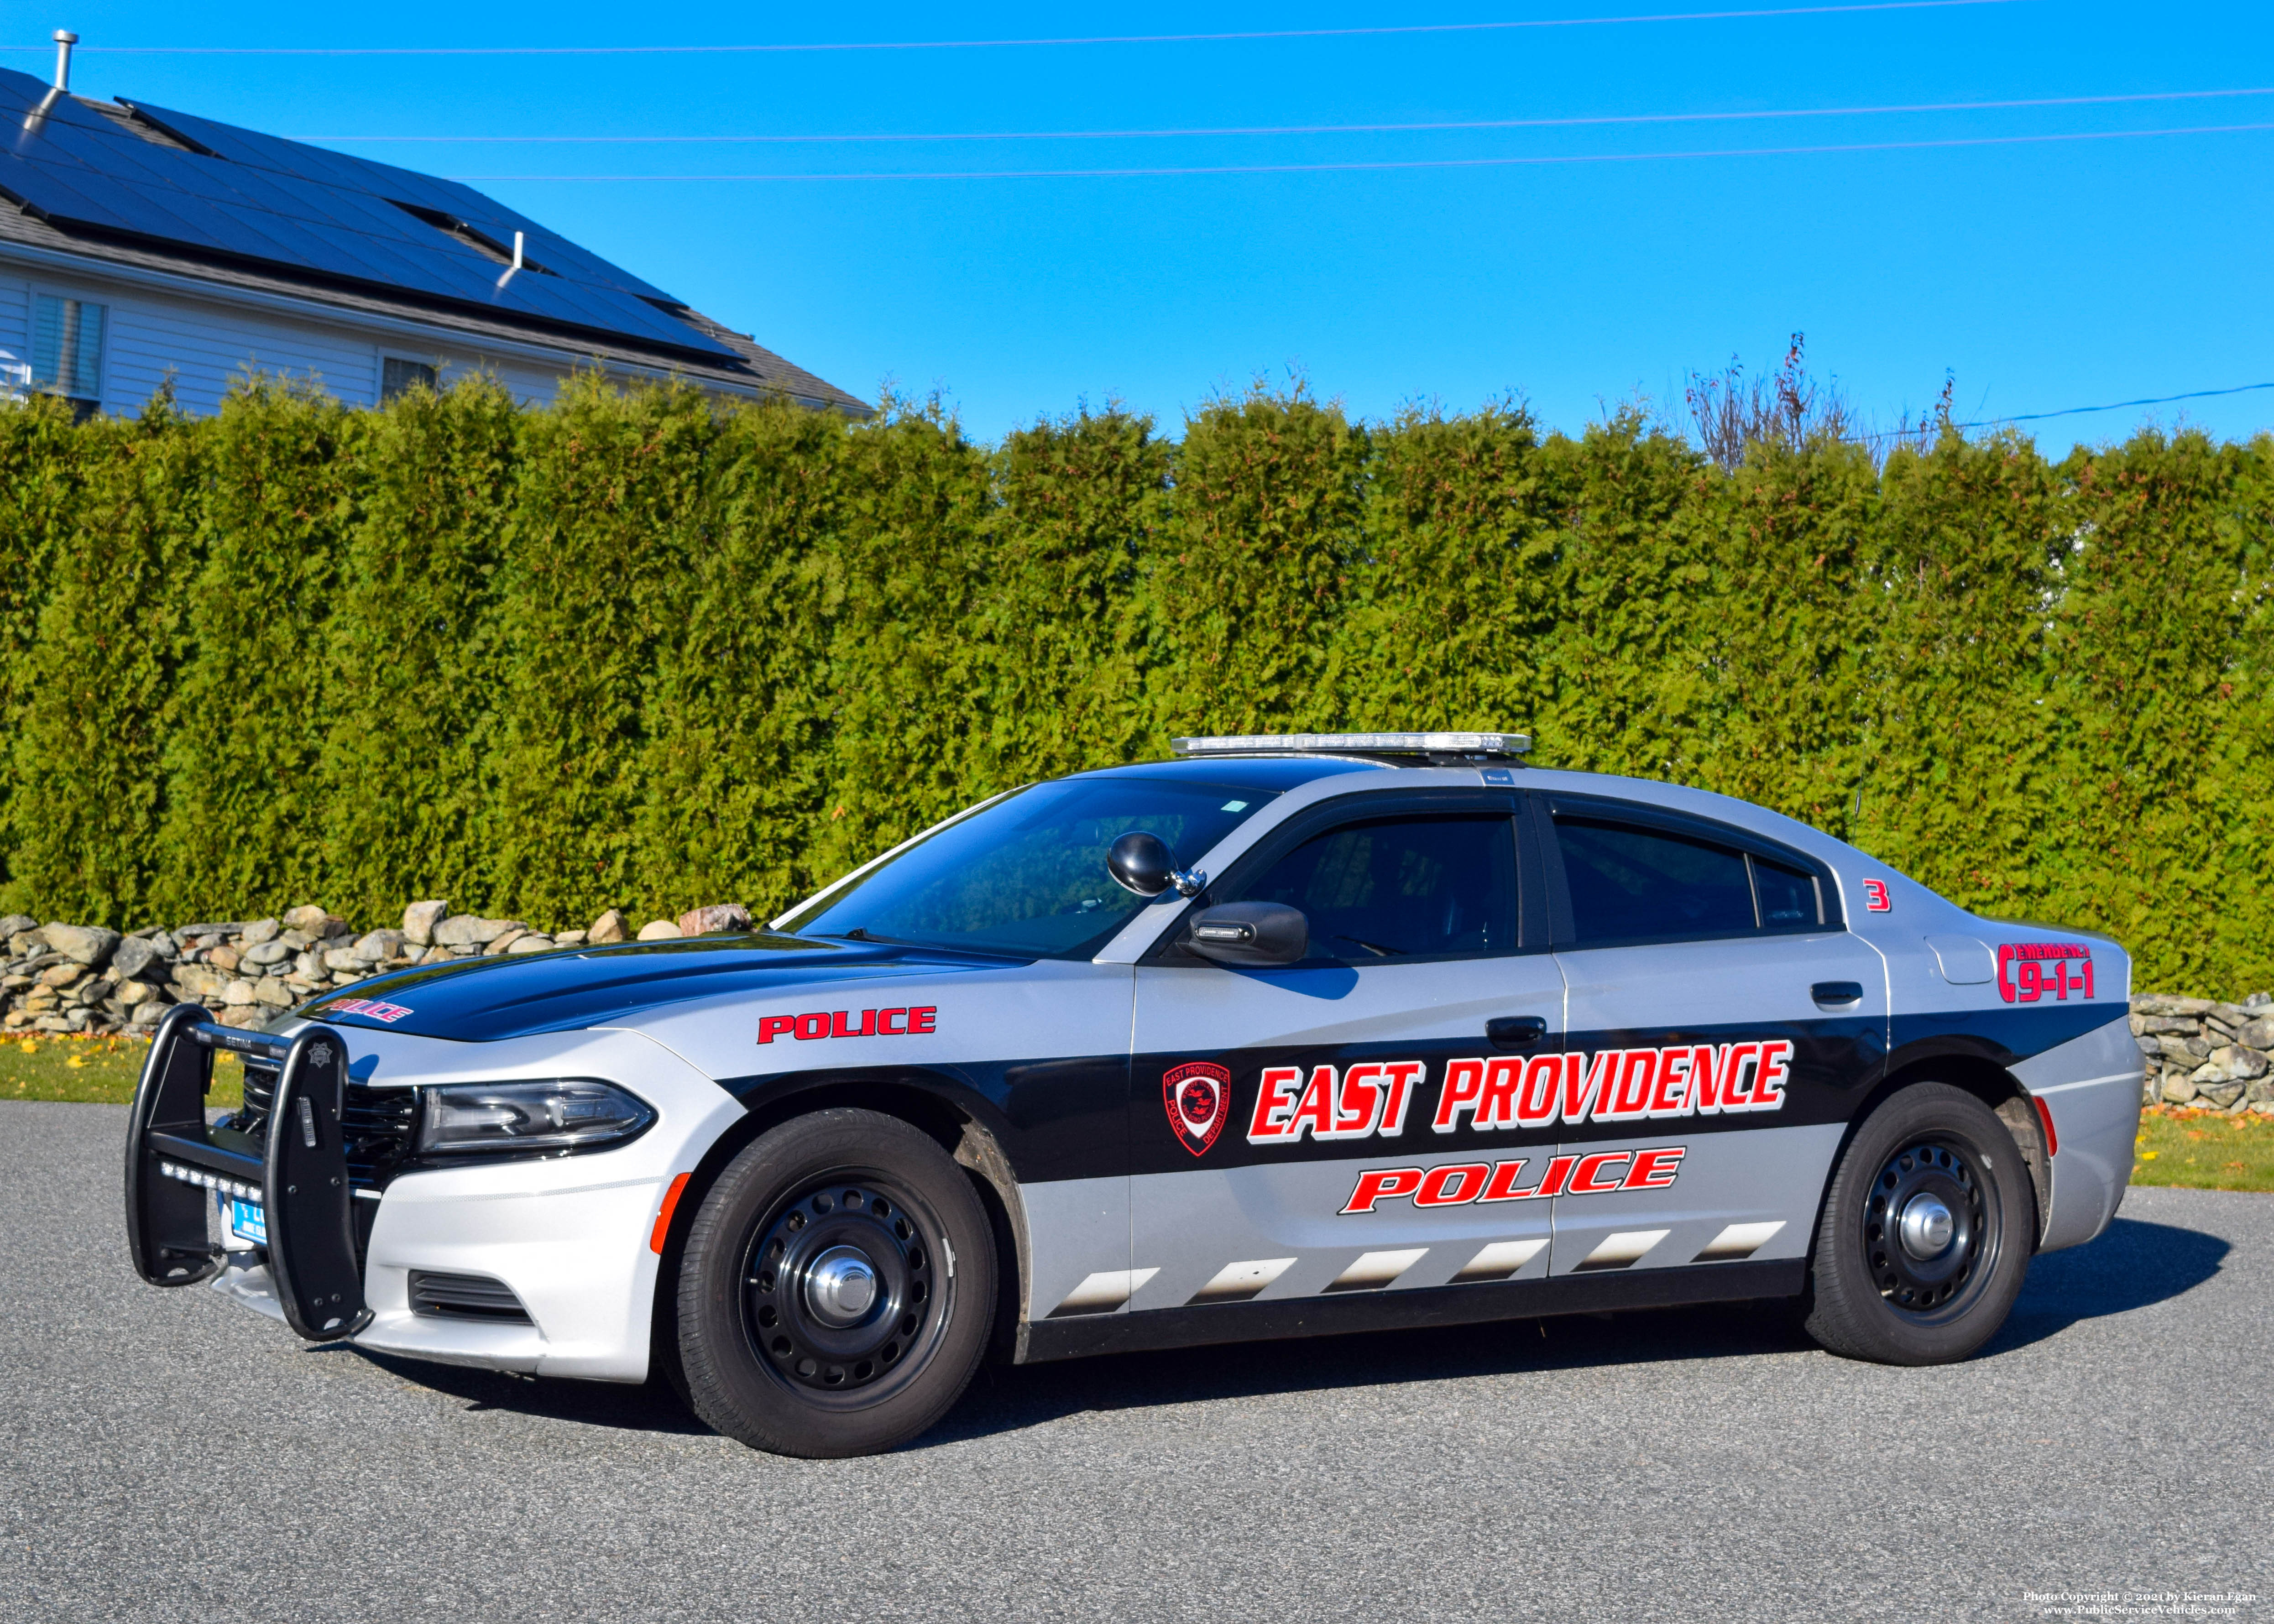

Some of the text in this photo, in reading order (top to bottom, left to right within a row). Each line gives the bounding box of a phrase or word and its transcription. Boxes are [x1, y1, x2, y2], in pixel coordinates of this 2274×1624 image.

[1863, 878, 1892, 913] 3
[2018, 959, 2094, 1003] 9-1-1
[315, 999, 414, 1023] POLICE
[757, 1006, 937, 1044] POLICE
[226, 1036, 252, 1049] SETINA
[1166, 1065, 1228, 1086] EAST PROVIDENCE
[1247, 1039, 1793, 1144] EAST PROVIDENCE
[1168, 1085, 1228, 1144] POLICE DEPARTMENT
[1337, 1145, 1687, 1216] POLICE
